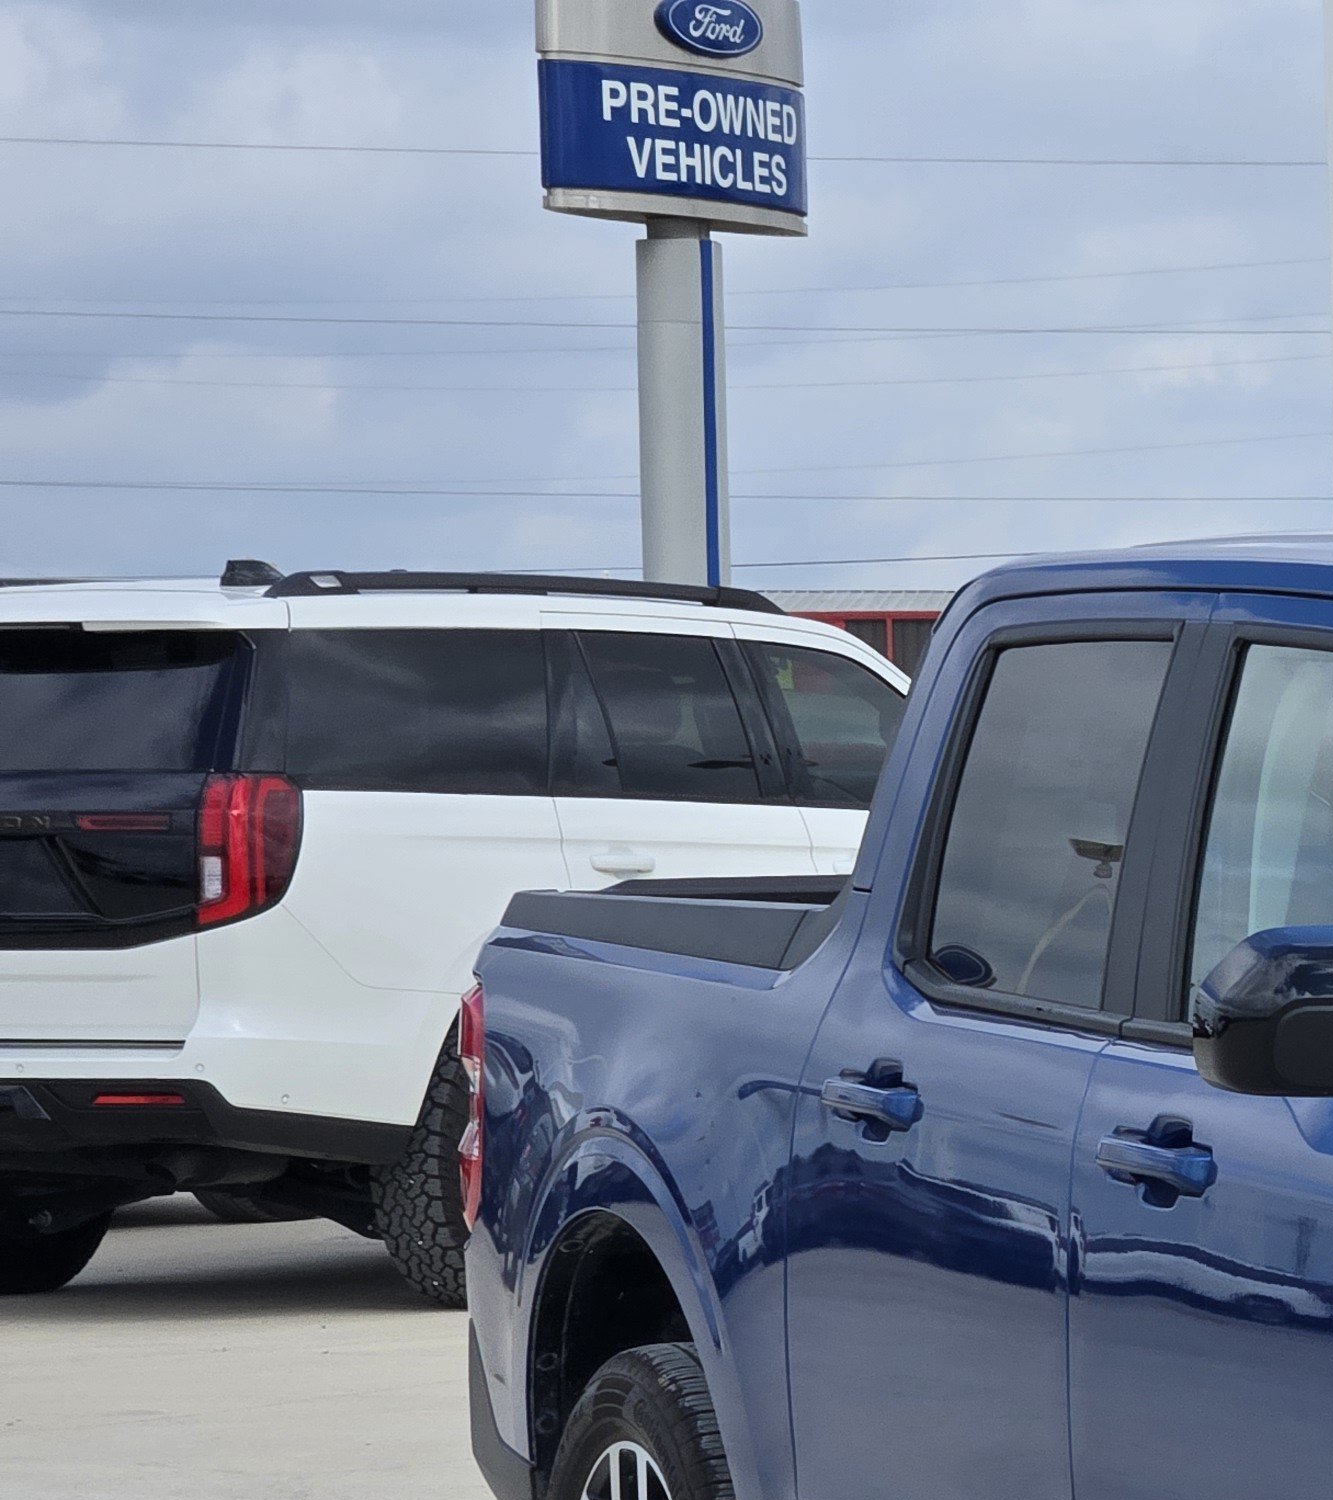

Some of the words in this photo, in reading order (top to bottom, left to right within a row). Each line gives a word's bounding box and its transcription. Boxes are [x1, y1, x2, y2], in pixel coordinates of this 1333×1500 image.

[689, 4, 745, 43] Ford
[601, 79, 797, 146] PRE-OWNED
[627, 136, 787, 196] VEHICLES
